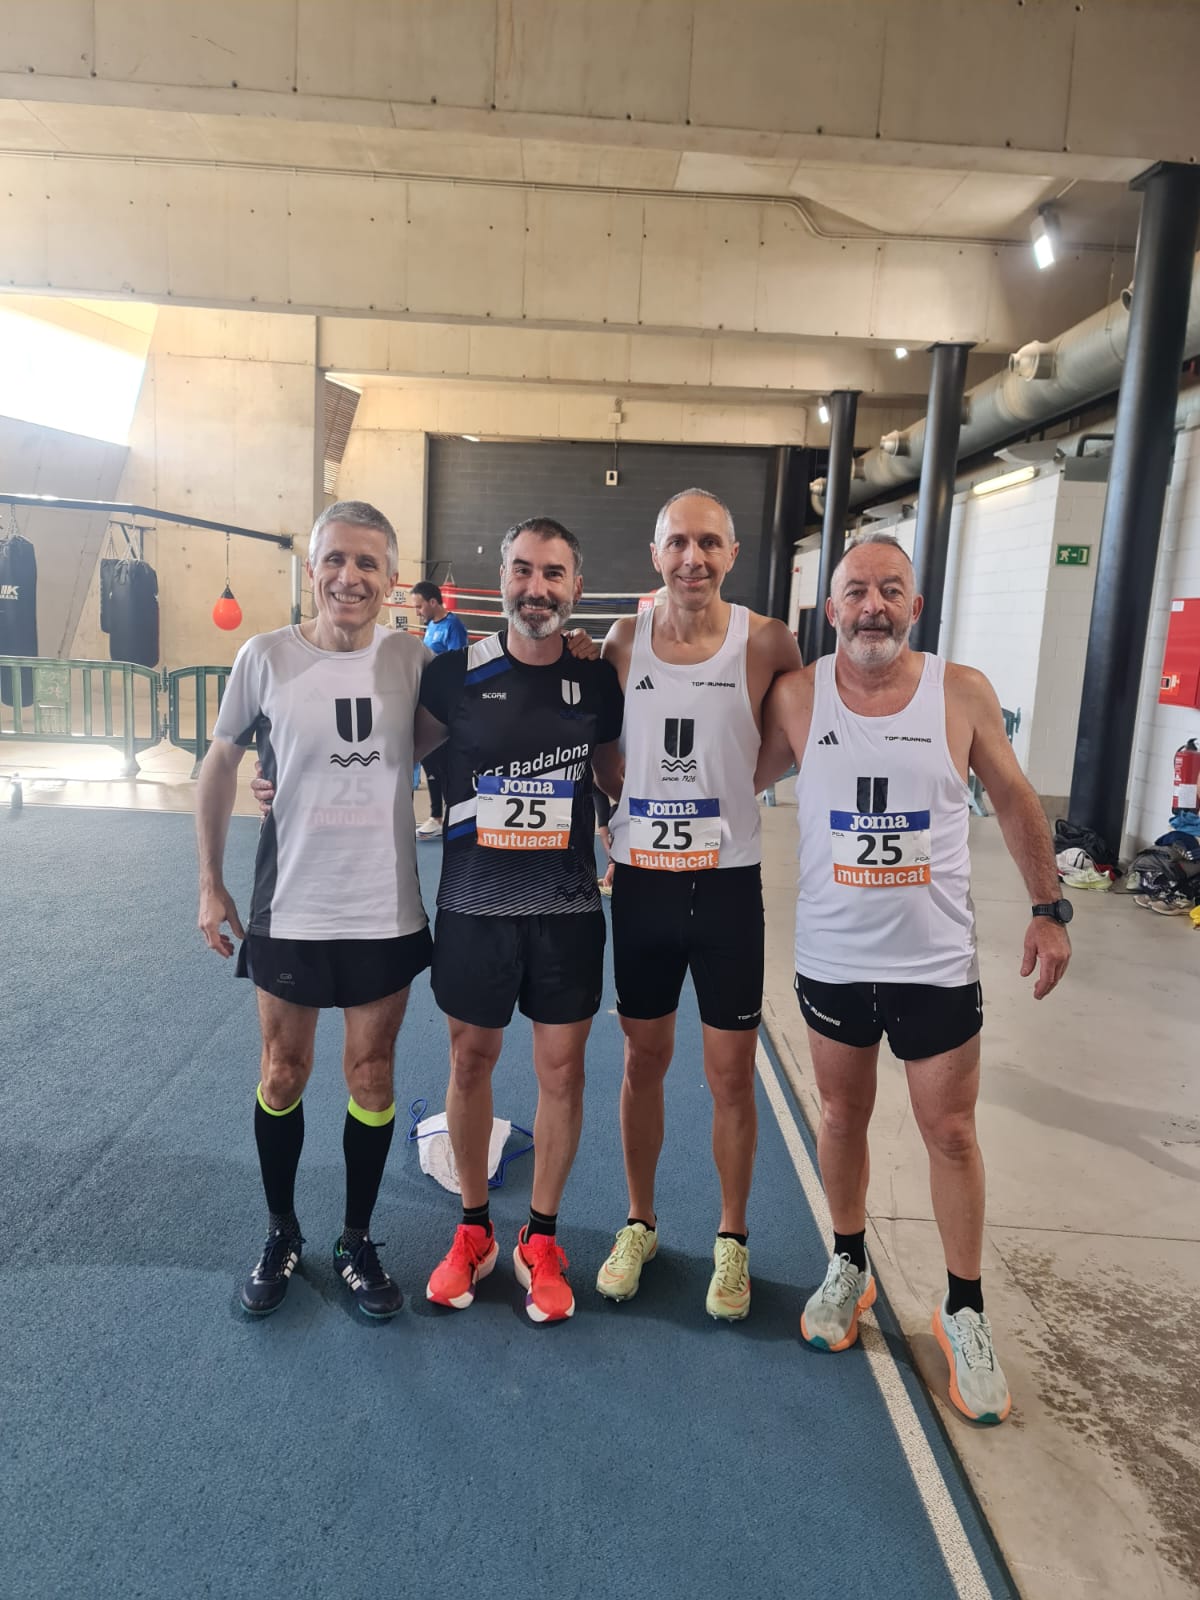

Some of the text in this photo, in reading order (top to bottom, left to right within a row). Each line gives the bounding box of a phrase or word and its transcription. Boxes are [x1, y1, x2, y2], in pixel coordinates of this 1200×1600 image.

[509, 743, 589, 778] Badalona
[504, 798, 547, 829] 25
[482, 832, 563, 848] mutuacat
[651, 820, 692, 850] 25
[856, 834, 903, 866] 25
[635, 852, 714, 869] mutuacat
[837, 867, 926, 885] mutuacat
